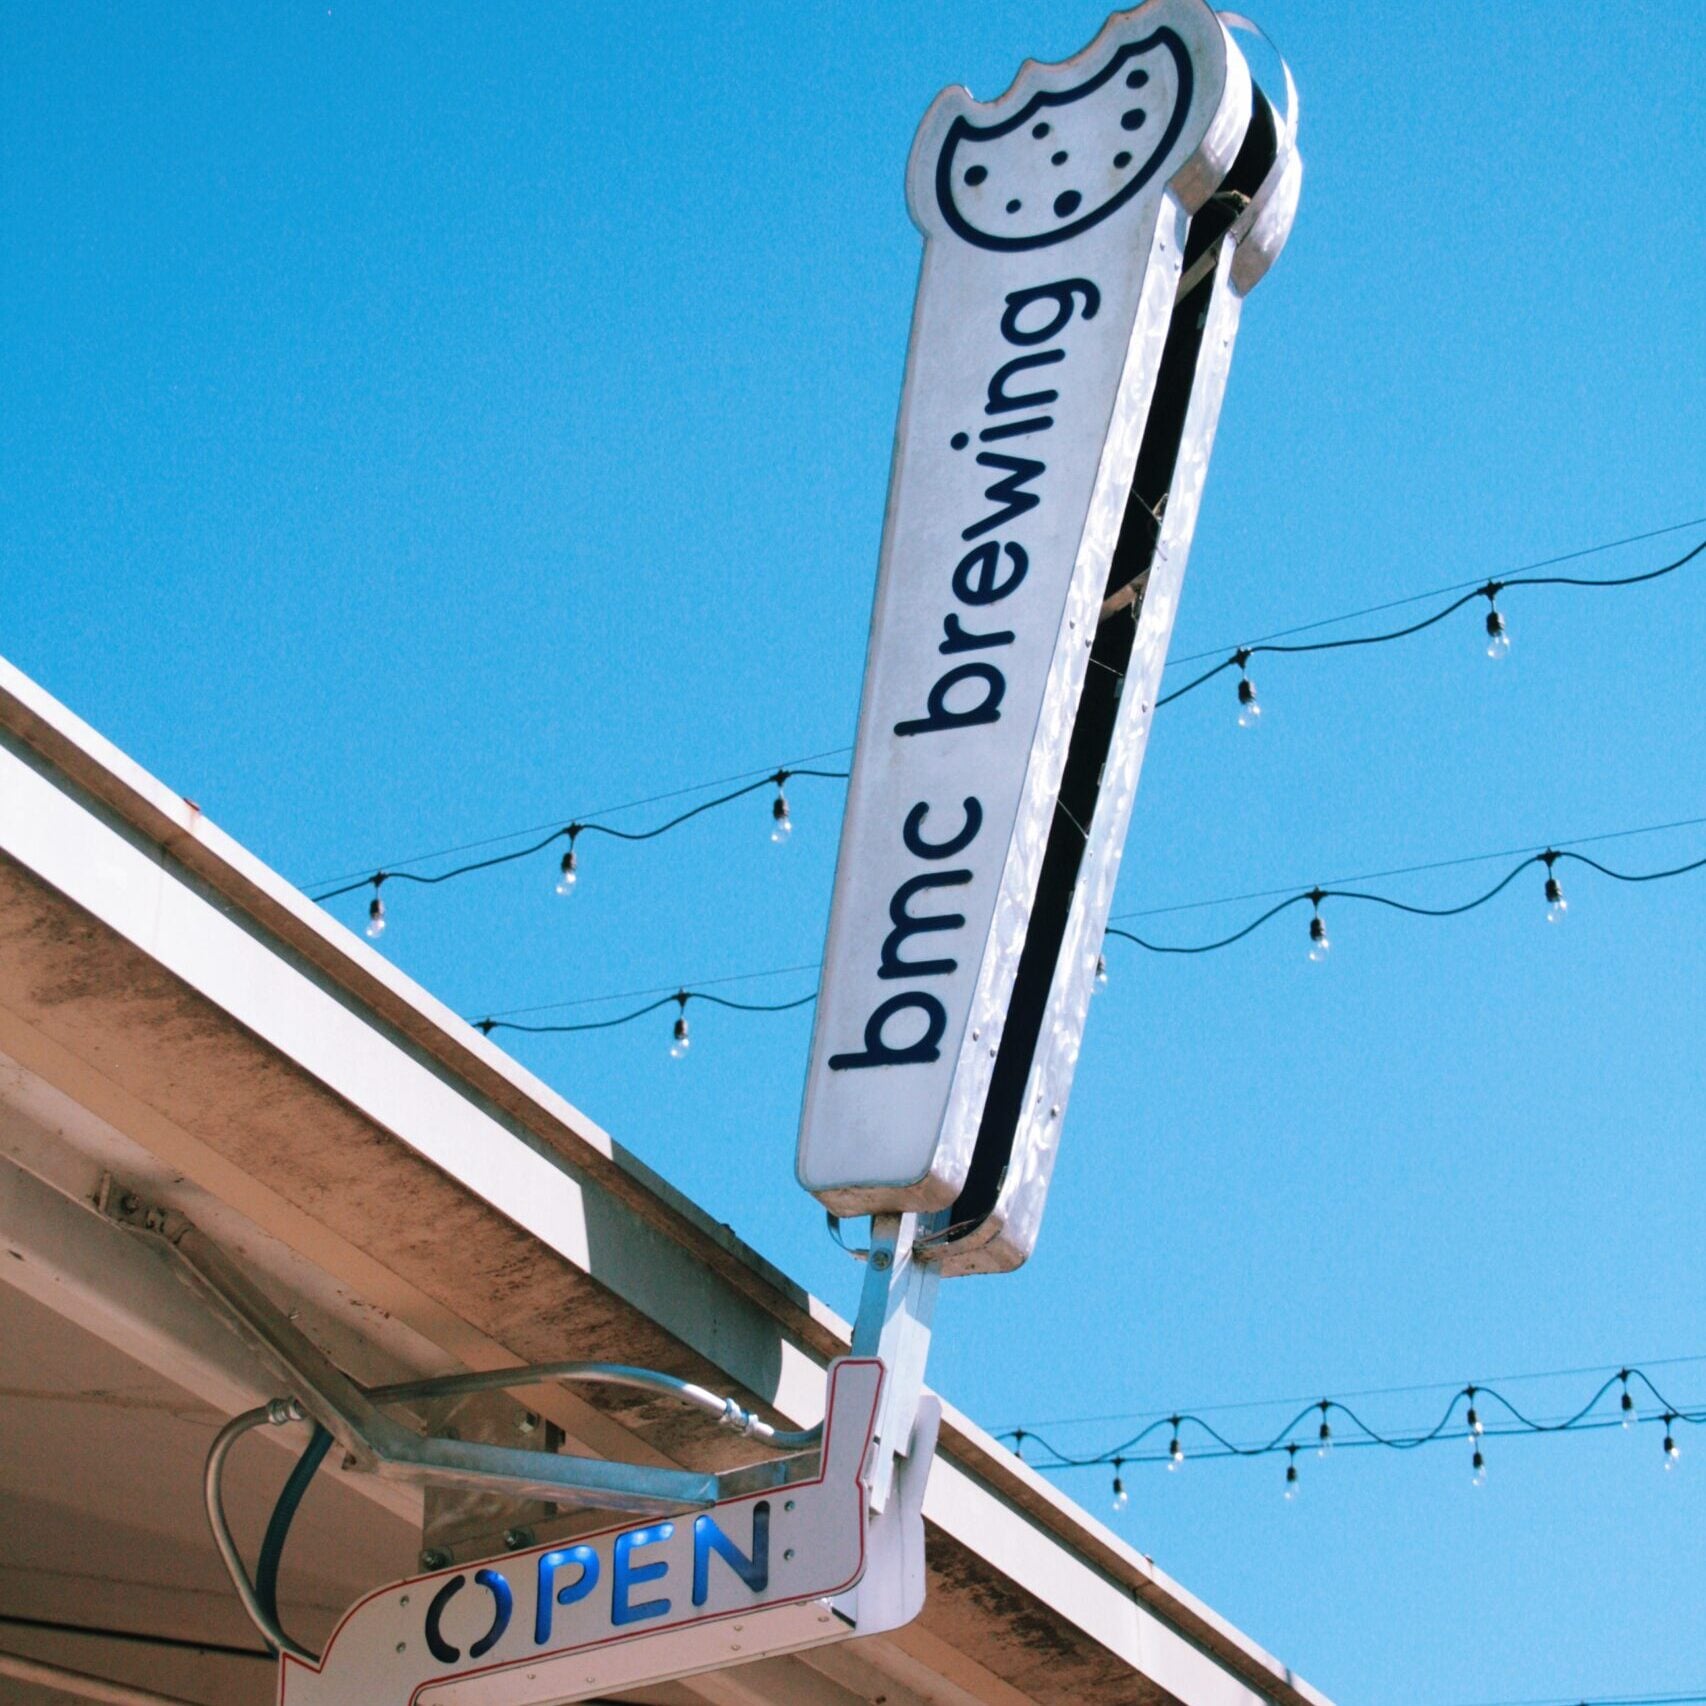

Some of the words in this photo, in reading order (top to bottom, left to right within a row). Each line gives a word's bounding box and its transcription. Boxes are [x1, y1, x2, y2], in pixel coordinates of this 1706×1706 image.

[894, 277, 1101, 736] brewing
[828, 796, 983, 1070] bmc
[424, 1500, 770, 1663] OPEN
